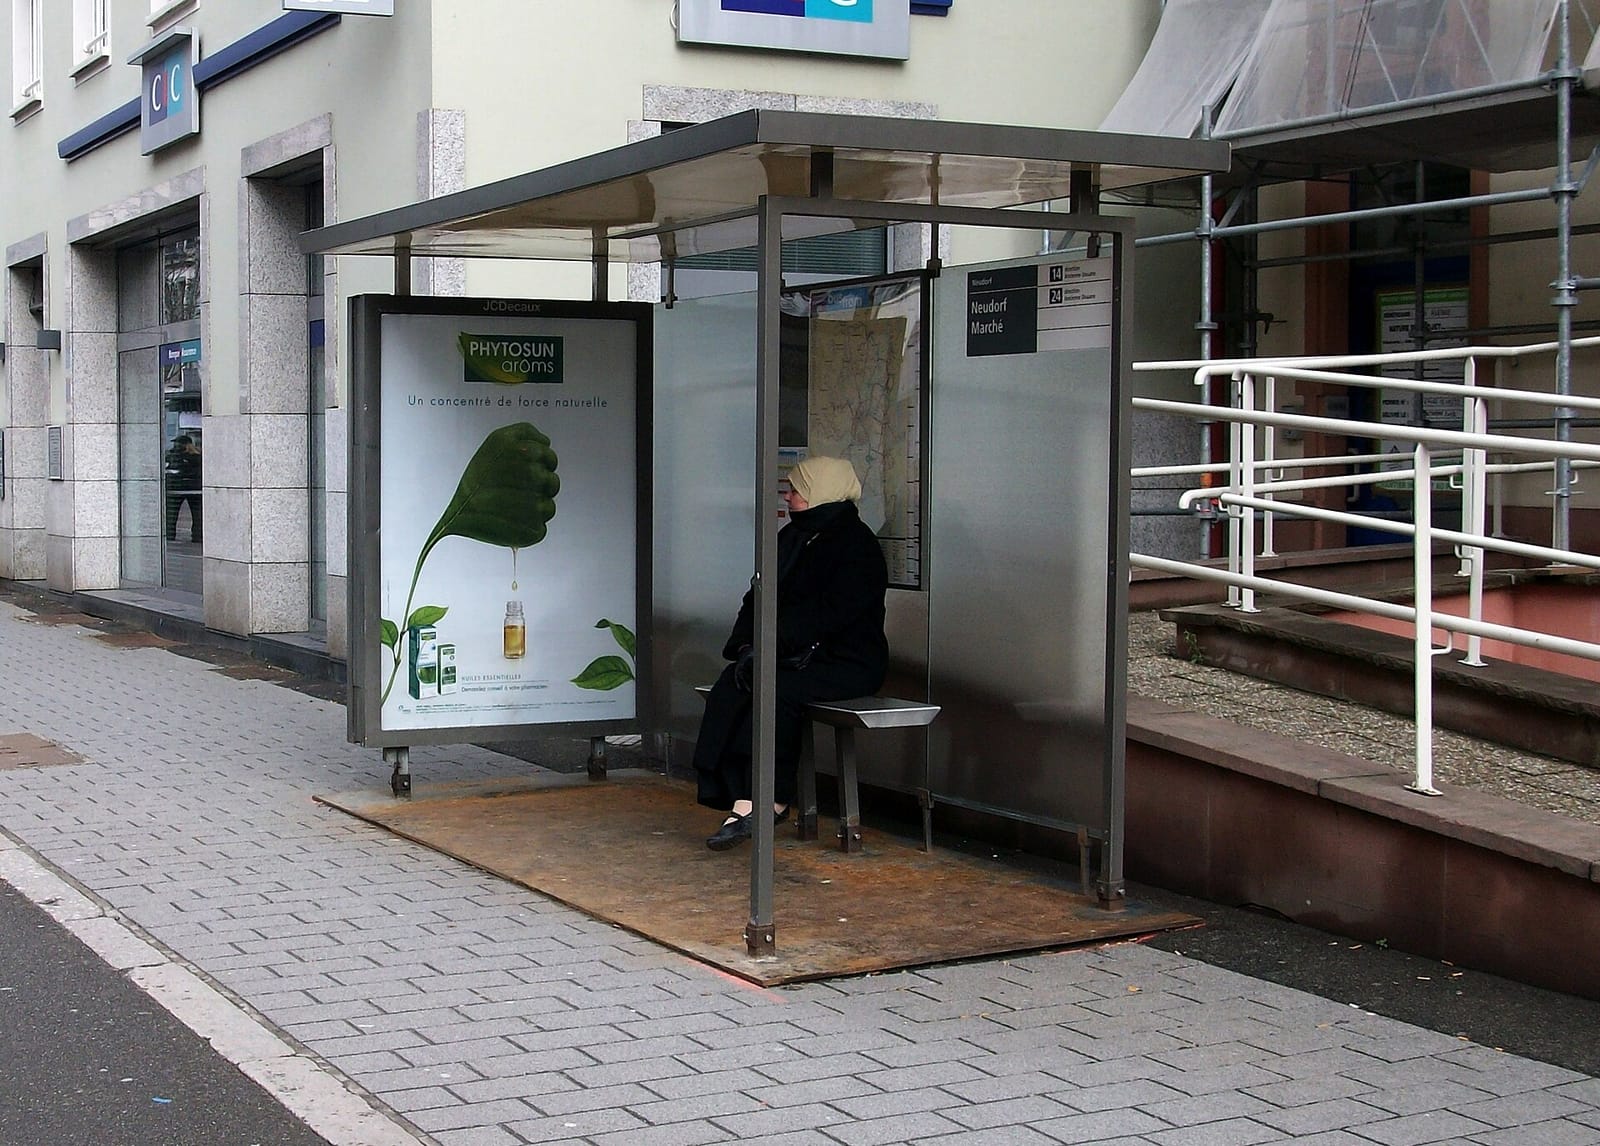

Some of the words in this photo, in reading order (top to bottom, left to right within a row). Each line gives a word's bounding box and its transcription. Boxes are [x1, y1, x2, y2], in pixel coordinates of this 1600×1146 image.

[152, 64, 180, 112] CIC
[1051, 267, 1062, 281] 14
[1051, 289, 1061, 303] 24
[483, 300, 541, 313] JCDecaux
[971, 298, 1008, 315] Neudorf
[971, 319, 1004, 335] Marché
[469, 341, 554, 357] PHYTOSUN
[408, 395, 424, 406] Un
[430, 396, 491, 407] concentré
[498, 396, 512, 407] de
[518, 396, 549, 408] force
[555, 397, 608, 408] naturelle
